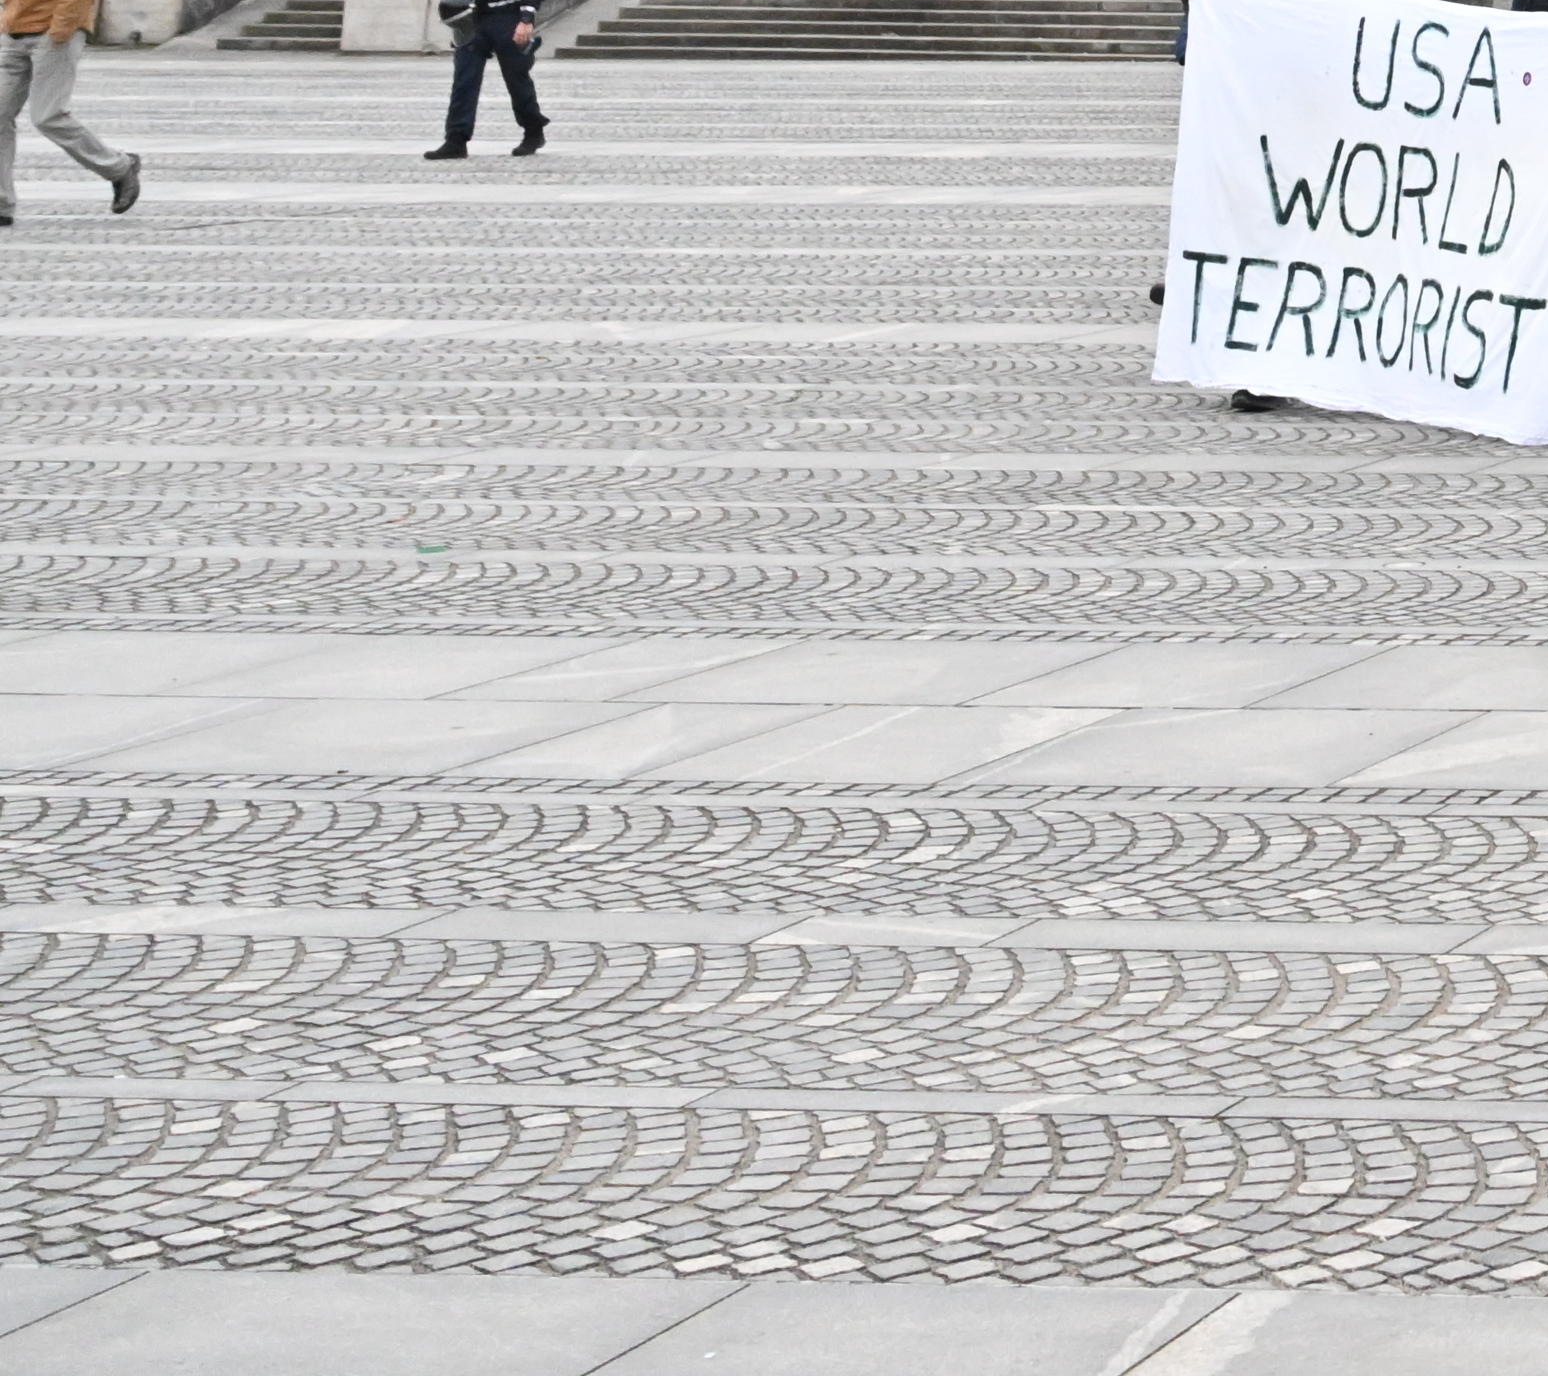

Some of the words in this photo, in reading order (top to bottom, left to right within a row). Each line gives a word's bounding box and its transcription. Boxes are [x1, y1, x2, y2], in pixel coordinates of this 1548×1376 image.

[1351, 17, 1501, 124] USA
[1260, 134, 1515, 255] WORLD
[1183, 250, 1547, 394] TERRORIST
